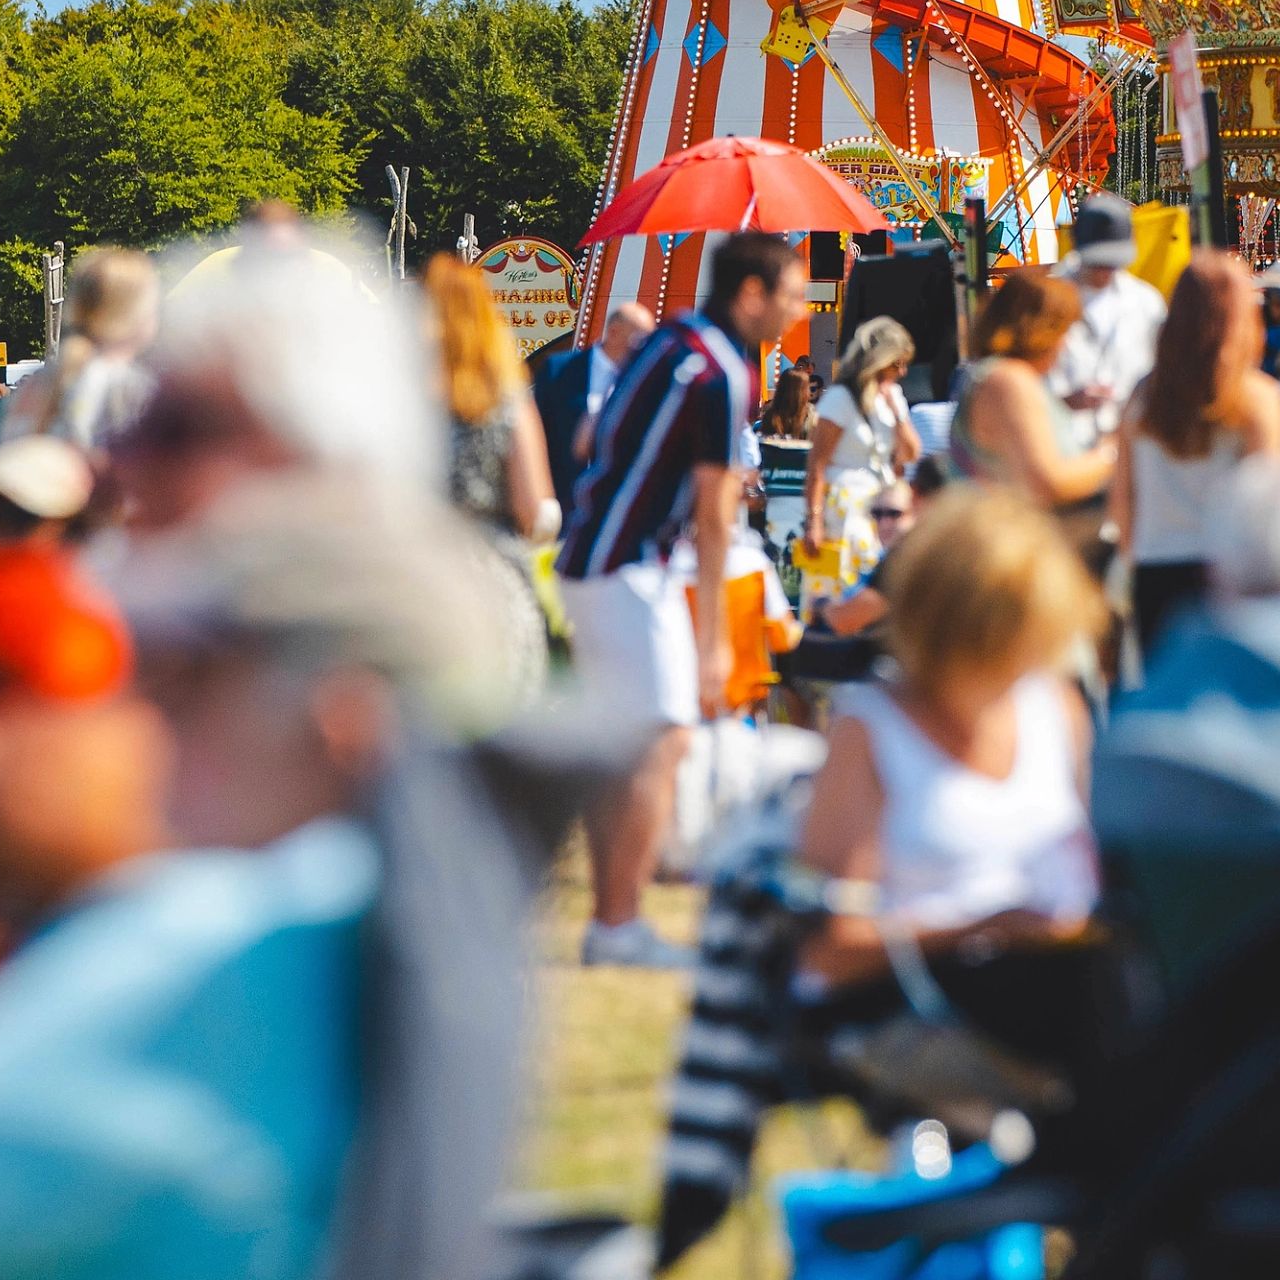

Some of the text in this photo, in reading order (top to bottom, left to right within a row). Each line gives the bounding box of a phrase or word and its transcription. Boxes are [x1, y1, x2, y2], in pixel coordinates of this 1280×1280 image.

[869, 163, 924, 179] GIAT
[491, 288, 566, 304] MAZING
[543, 310, 572, 328] OF
